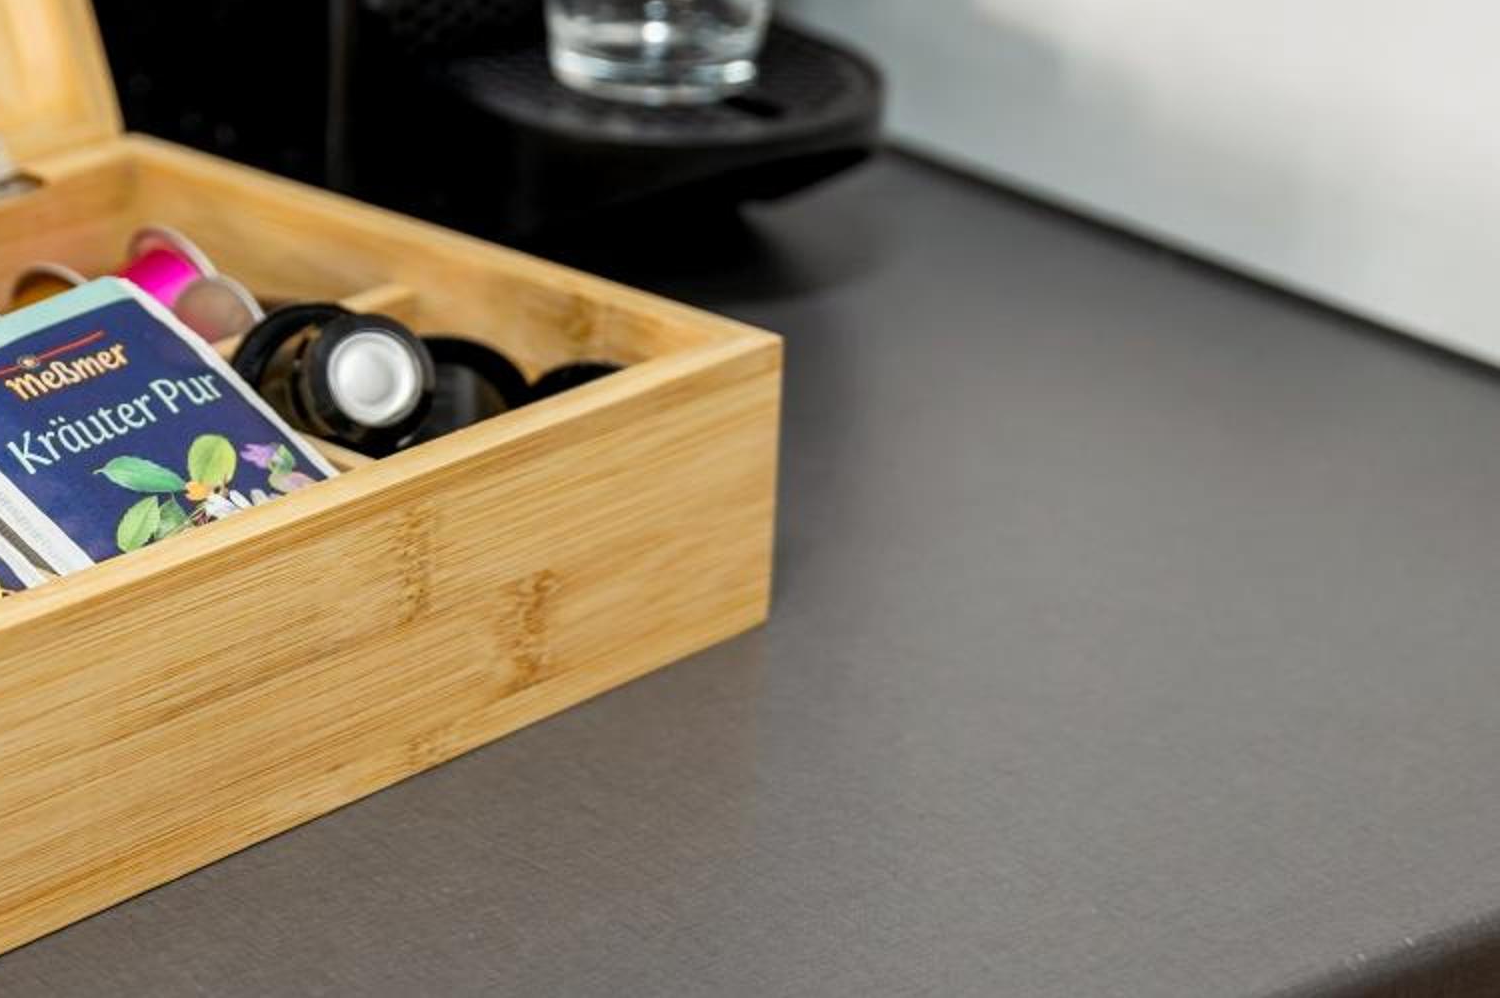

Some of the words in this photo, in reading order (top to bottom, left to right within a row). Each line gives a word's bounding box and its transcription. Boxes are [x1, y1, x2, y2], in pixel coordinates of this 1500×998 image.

[4, 343, 129, 400] Meßmer
[7, 395, 156, 474] Kräuter
[149, 374, 222, 414] Pur
